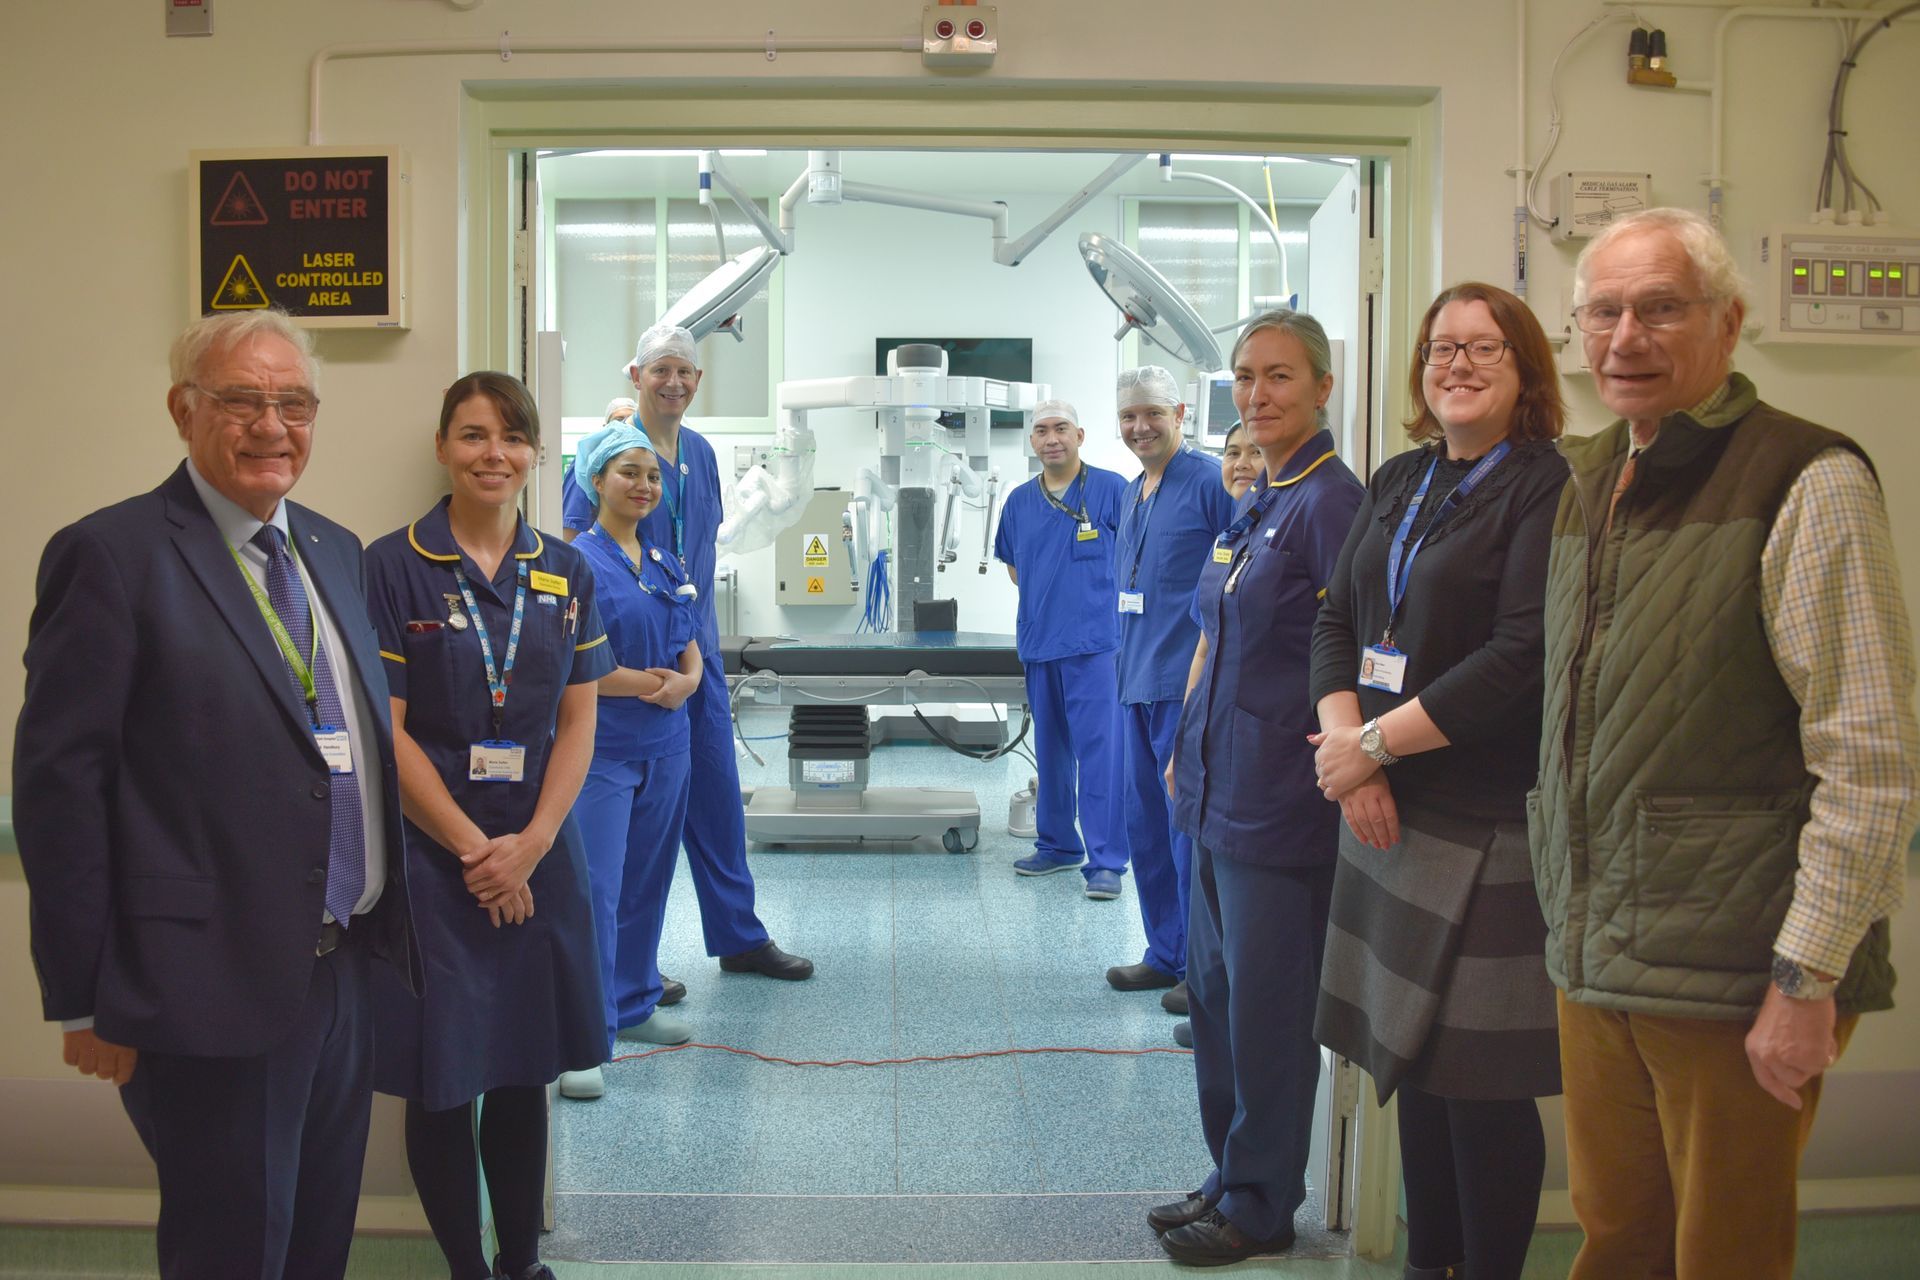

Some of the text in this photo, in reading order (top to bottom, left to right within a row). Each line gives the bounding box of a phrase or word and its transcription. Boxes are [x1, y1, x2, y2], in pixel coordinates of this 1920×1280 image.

[284, 170, 372, 191] DO NOT
[290, 199, 367, 219] ENTER
[303, 252, 355, 267] LASER
[276, 272, 383, 287] CONTROLLED
[308, 292, 352, 306] AREA
[462, 590, 475, 606] NHS
[515, 594, 525, 612] NHS
[539, 595, 556, 603] NHS
[471, 613, 483, 630] NHS
[511, 618, 522, 636] NHS
[480, 638, 490, 656] NHS
[506, 642, 517, 661] NHS
